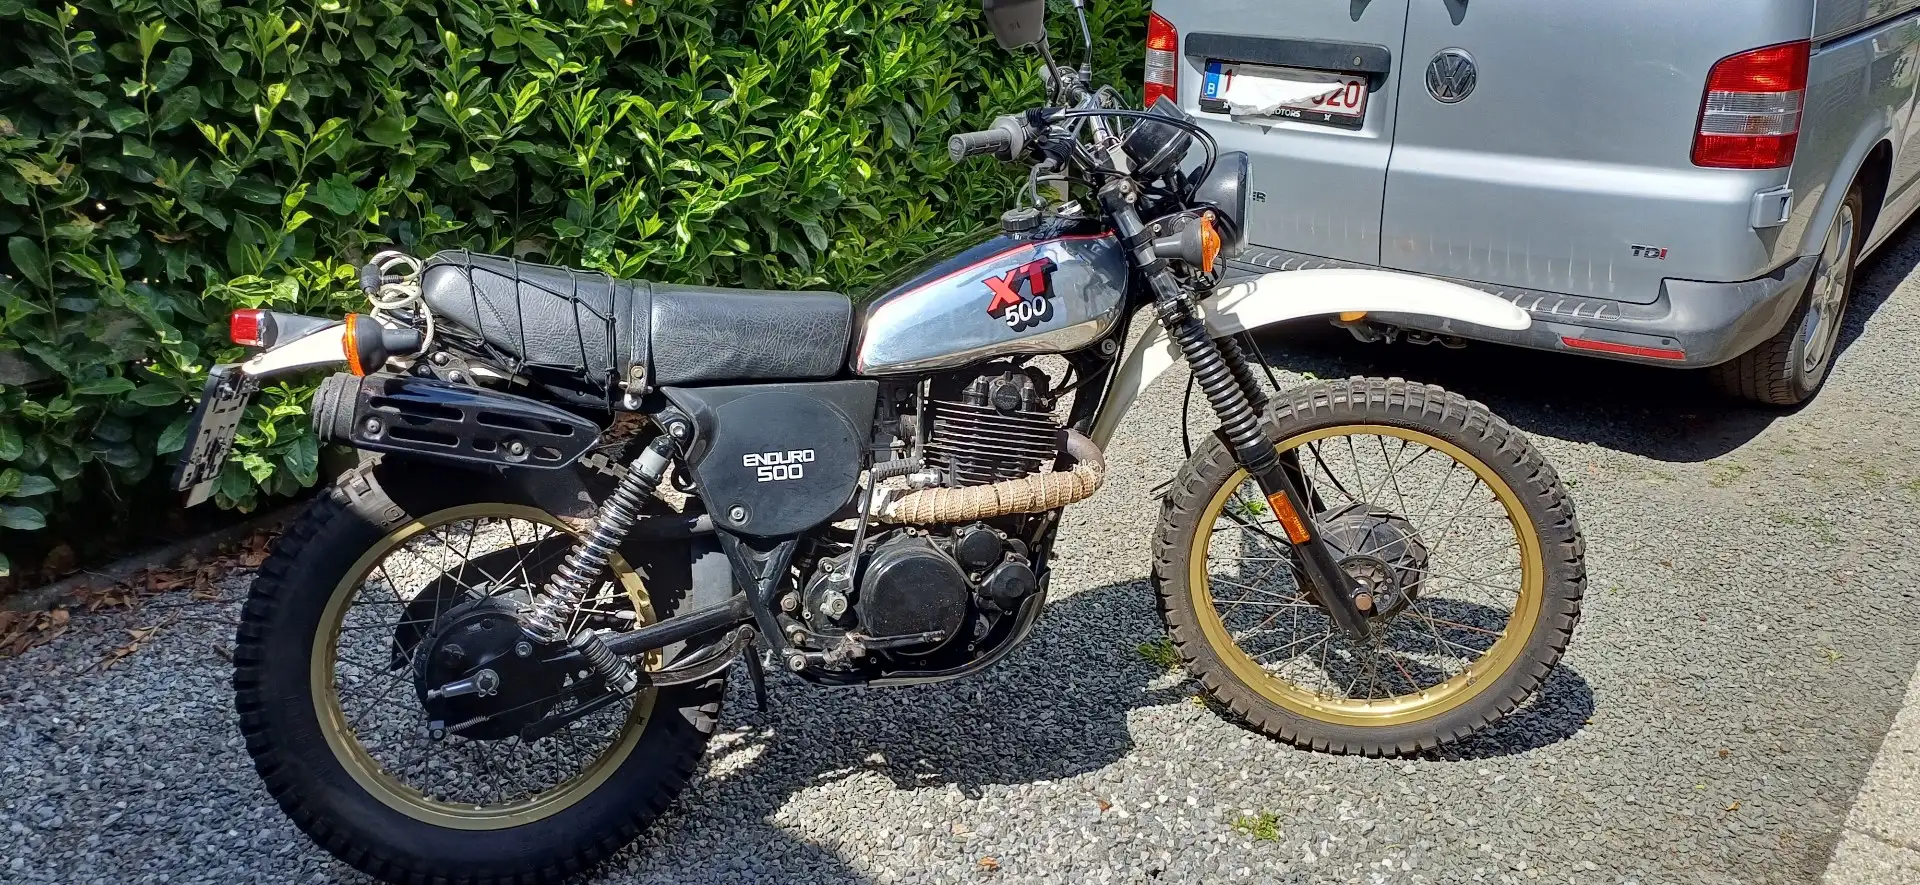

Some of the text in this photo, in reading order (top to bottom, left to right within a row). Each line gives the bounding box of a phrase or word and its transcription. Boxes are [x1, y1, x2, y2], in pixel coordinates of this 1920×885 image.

[1207, 82, 1216, 95] B
[1272, 108, 1301, 118] OTORS
[1631, 243, 1668, 260] TDI
[982, 256, 1055, 317] XT
[1005, 296, 1049, 328] 500
[743, 449, 815, 467] ENDURO
[757, 463, 804, 482] 500
